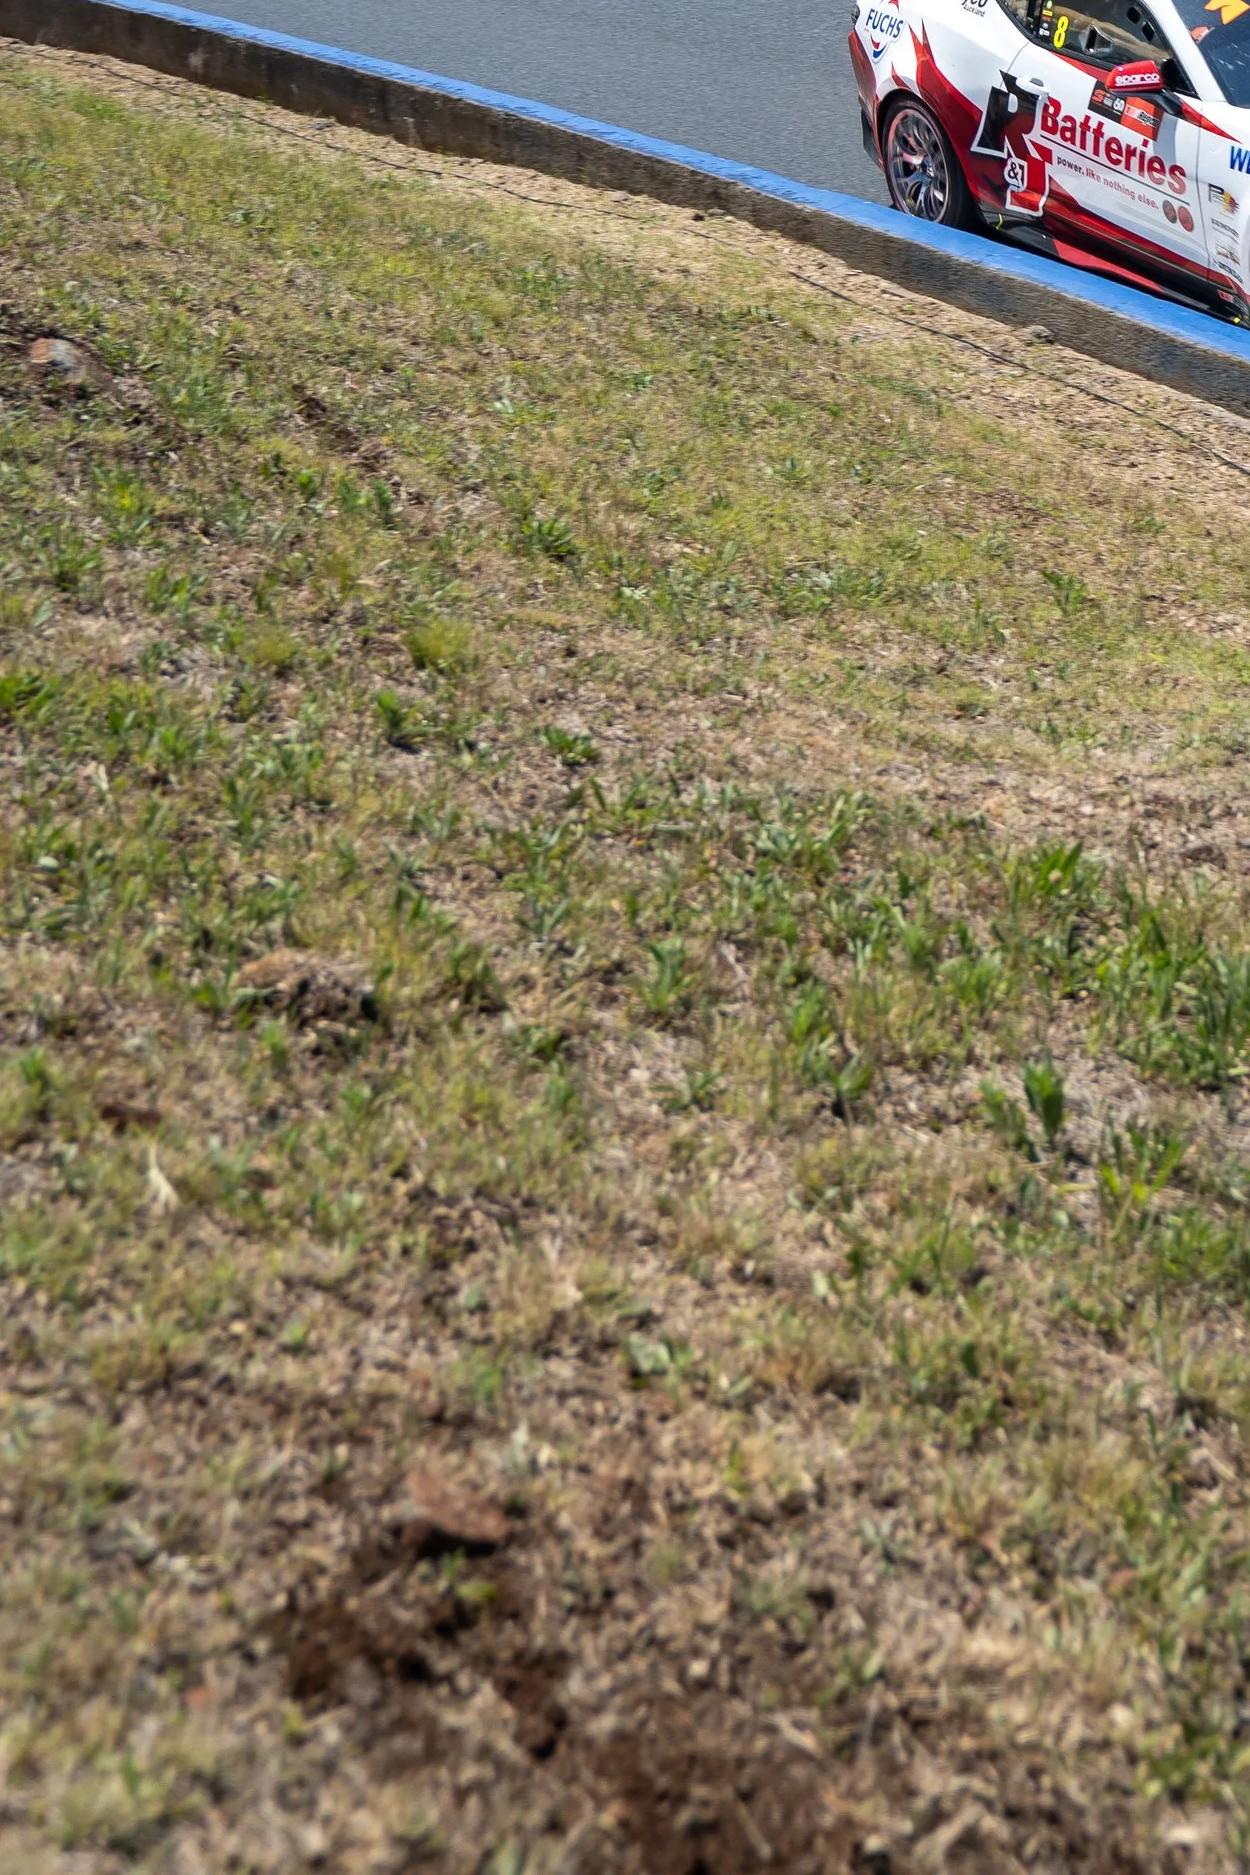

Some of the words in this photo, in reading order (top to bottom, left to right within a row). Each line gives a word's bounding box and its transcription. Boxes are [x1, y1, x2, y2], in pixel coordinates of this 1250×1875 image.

[865, 8, 904, 39] FUCHS
[1053, 15, 1069, 49] 8
[1115, 73, 1160, 86] sparco
[1040, 95, 1187, 195] Batteries
[1085, 167, 1102, 183] like
[1103, 178, 1135, 201] nothing
